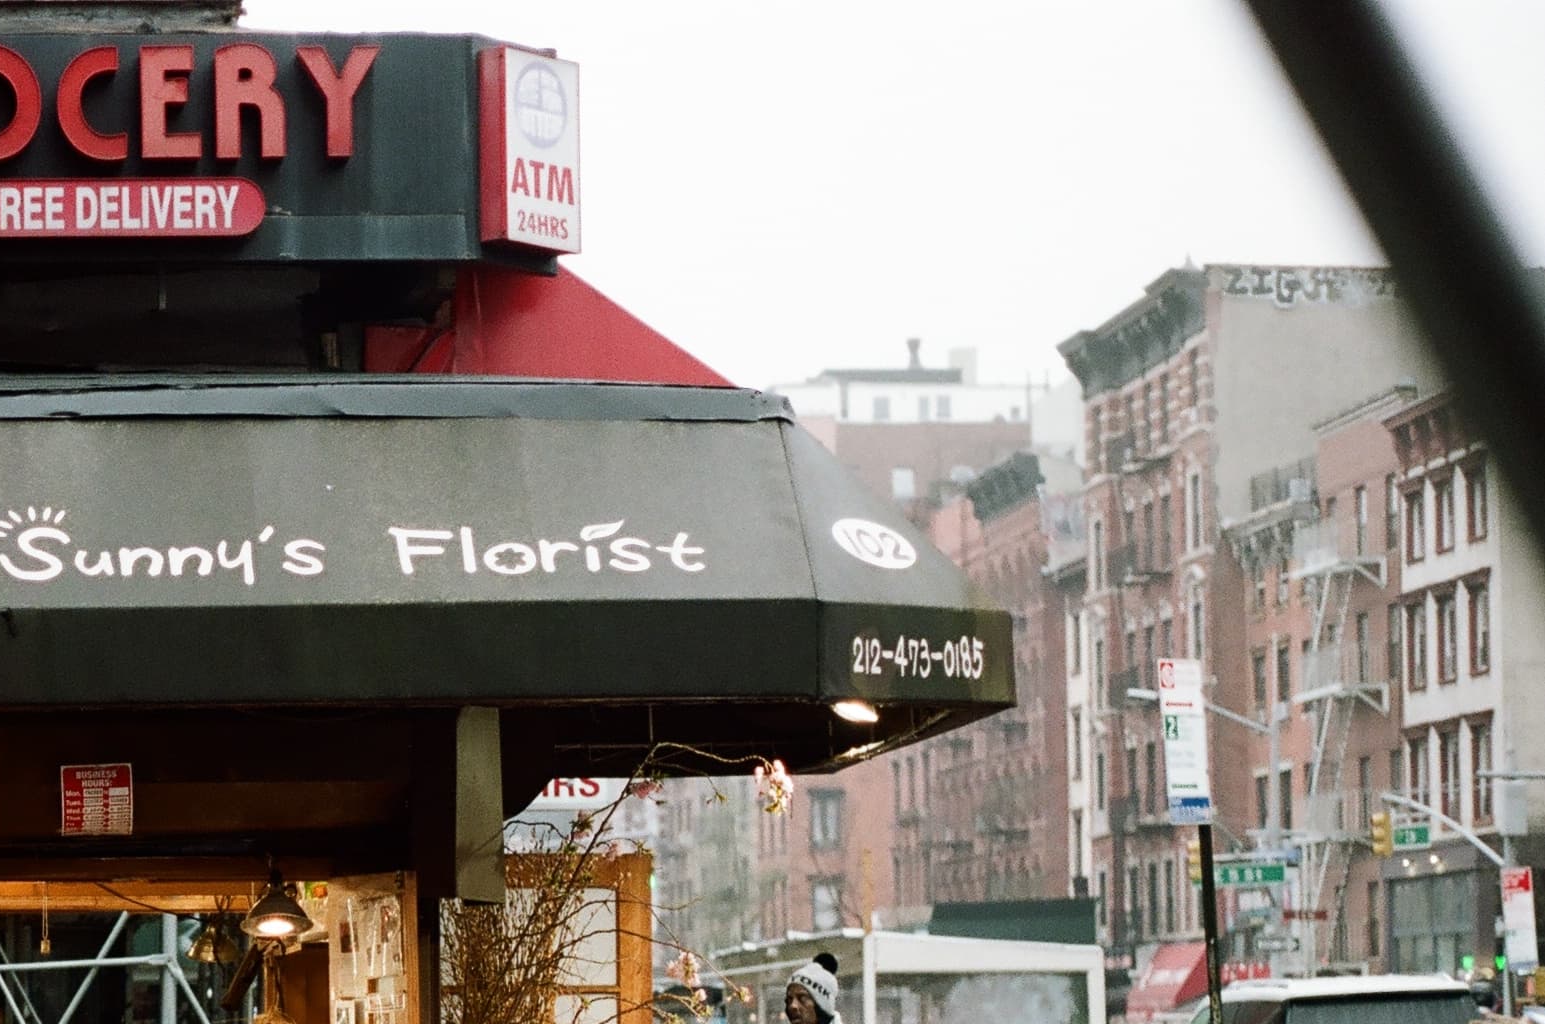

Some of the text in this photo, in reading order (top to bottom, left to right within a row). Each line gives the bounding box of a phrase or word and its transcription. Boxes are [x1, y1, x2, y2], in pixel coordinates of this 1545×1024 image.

[511, 157, 575, 206] ATM
[75, 185, 239, 230] DELIVERY
[516, 209, 569, 240] 24HRS
[388, 520, 707, 575] Florist
[841, 526, 913, 562] 102
[852, 634, 984, 680] 212-473-0185
